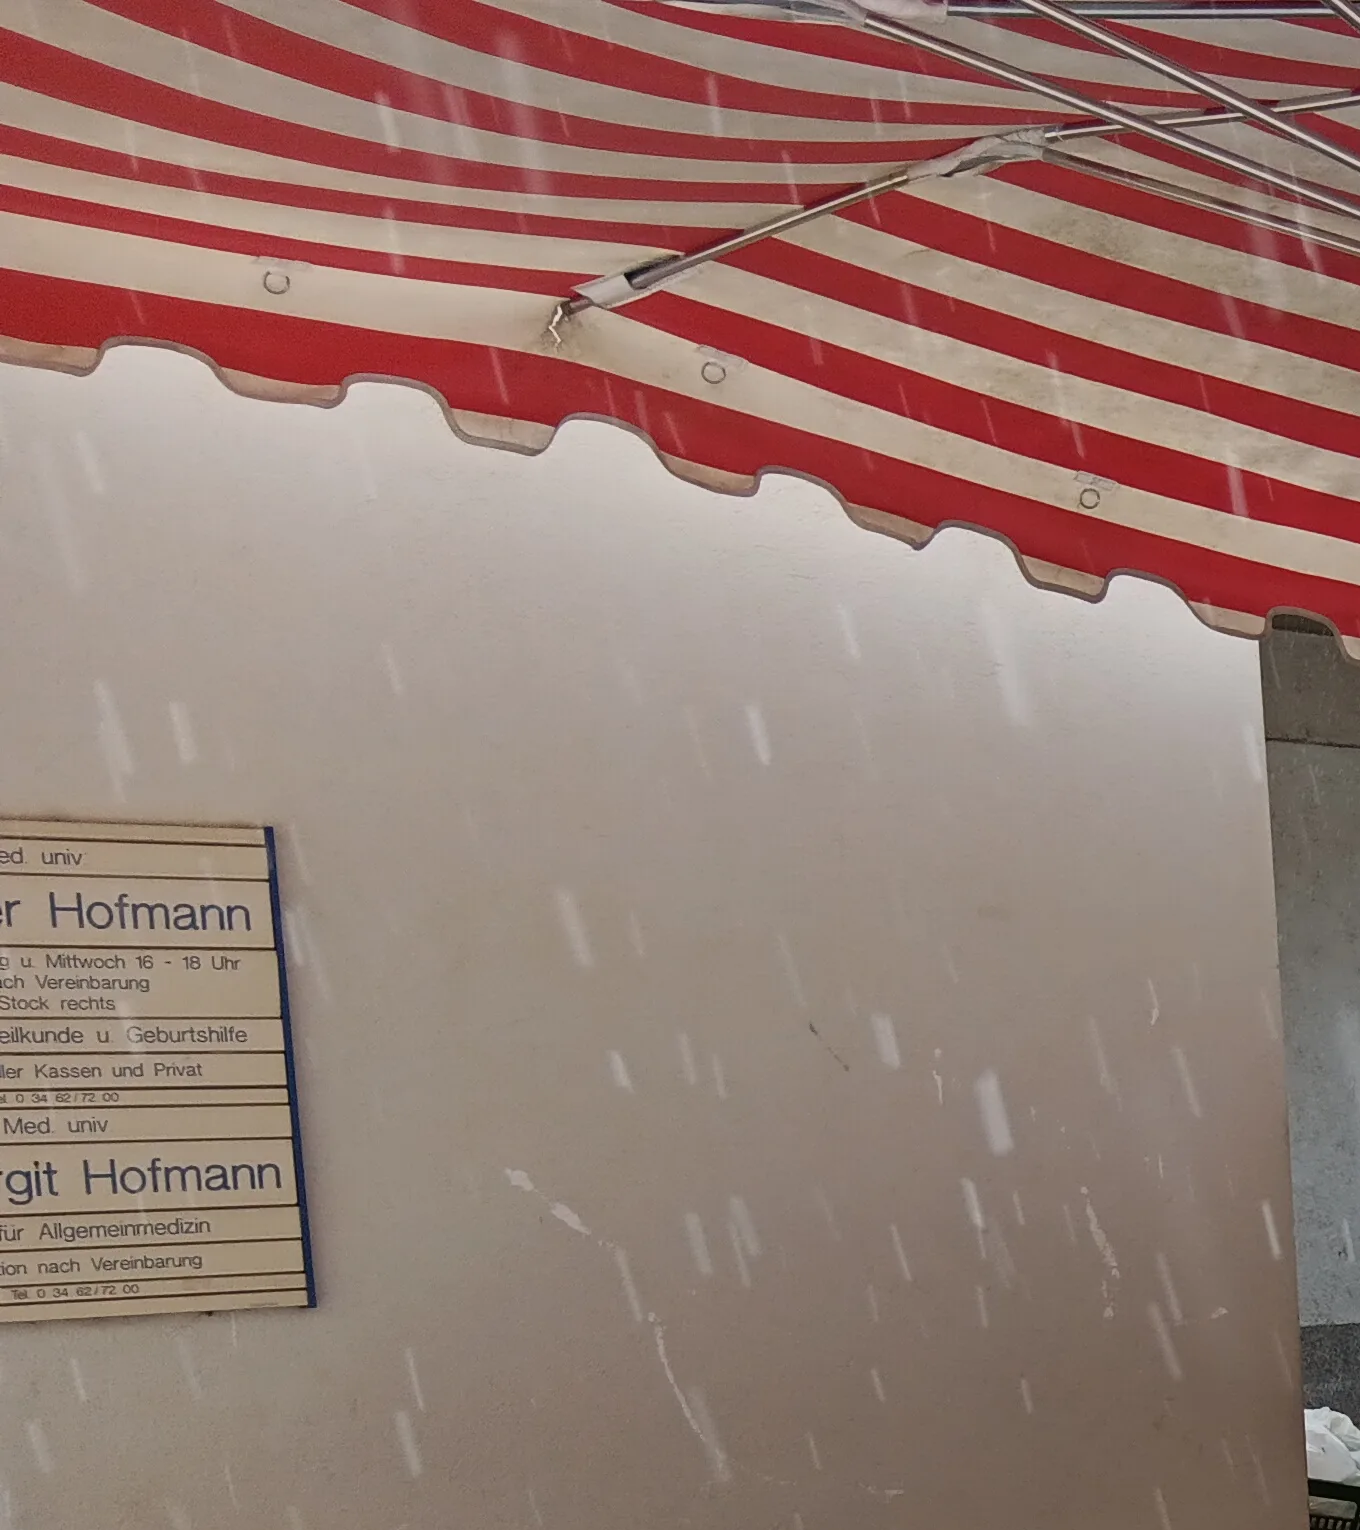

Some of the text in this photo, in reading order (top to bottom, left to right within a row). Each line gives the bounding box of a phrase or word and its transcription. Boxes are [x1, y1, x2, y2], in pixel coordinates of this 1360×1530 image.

[41, 848, 82, 866] univ
[49, 891, 251, 932] Hofmann
[45, 953, 125, 969] Mittwoch
[135, 955, 153, 969] 16
[182, 956, 201, 970] 18
[211, 955, 241, 970] Uhr
[0, 974, 150, 992] ch Vereinbarung
[60, 996, 116, 1010] rechts
[126, 1025, 248, 1044] Geburtshilfe
[34, 1063, 102, 1079] Kassen
[112, 1063, 144, 1077] und
[153, 1062, 203, 1077] Privat
[31, 1093, 48, 1103] 34
[102, 1092, 120, 1102] 00
[67, 1116, 108, 1133] univ
[0, 1158, 282, 1205] git Hofmann
[39, 1217, 211, 1242] Allgemeinmedizin
[0, 1255, 203, 1275] ion nach Vereinbarung
[52, 1287, 69, 1298] 34
[122, 1283, 140, 1294] 00
